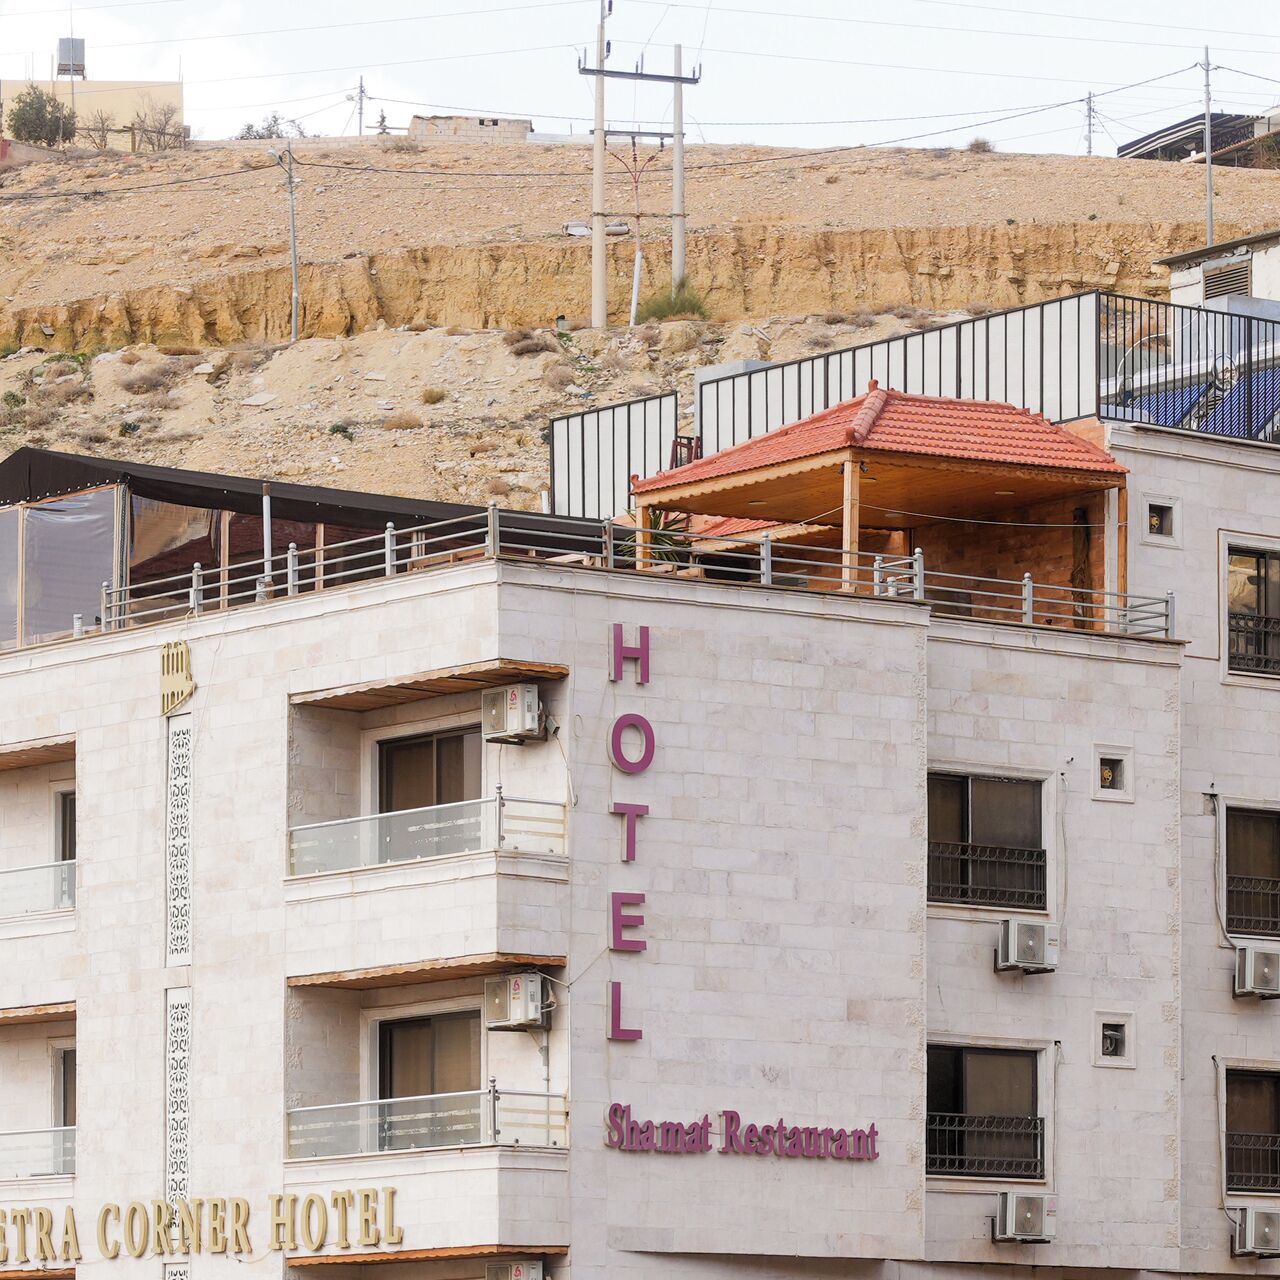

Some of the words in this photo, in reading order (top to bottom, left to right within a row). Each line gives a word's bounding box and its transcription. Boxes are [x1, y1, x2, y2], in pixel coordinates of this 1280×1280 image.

[607, 622, 655, 1041] HOTEL
[605, 1101, 713, 1155] Shamat
[718, 1108, 880, 1161] Restaurant
[97, 1196, 252, 1260] CORNER
[267, 1185, 404, 1252] HOTEL
